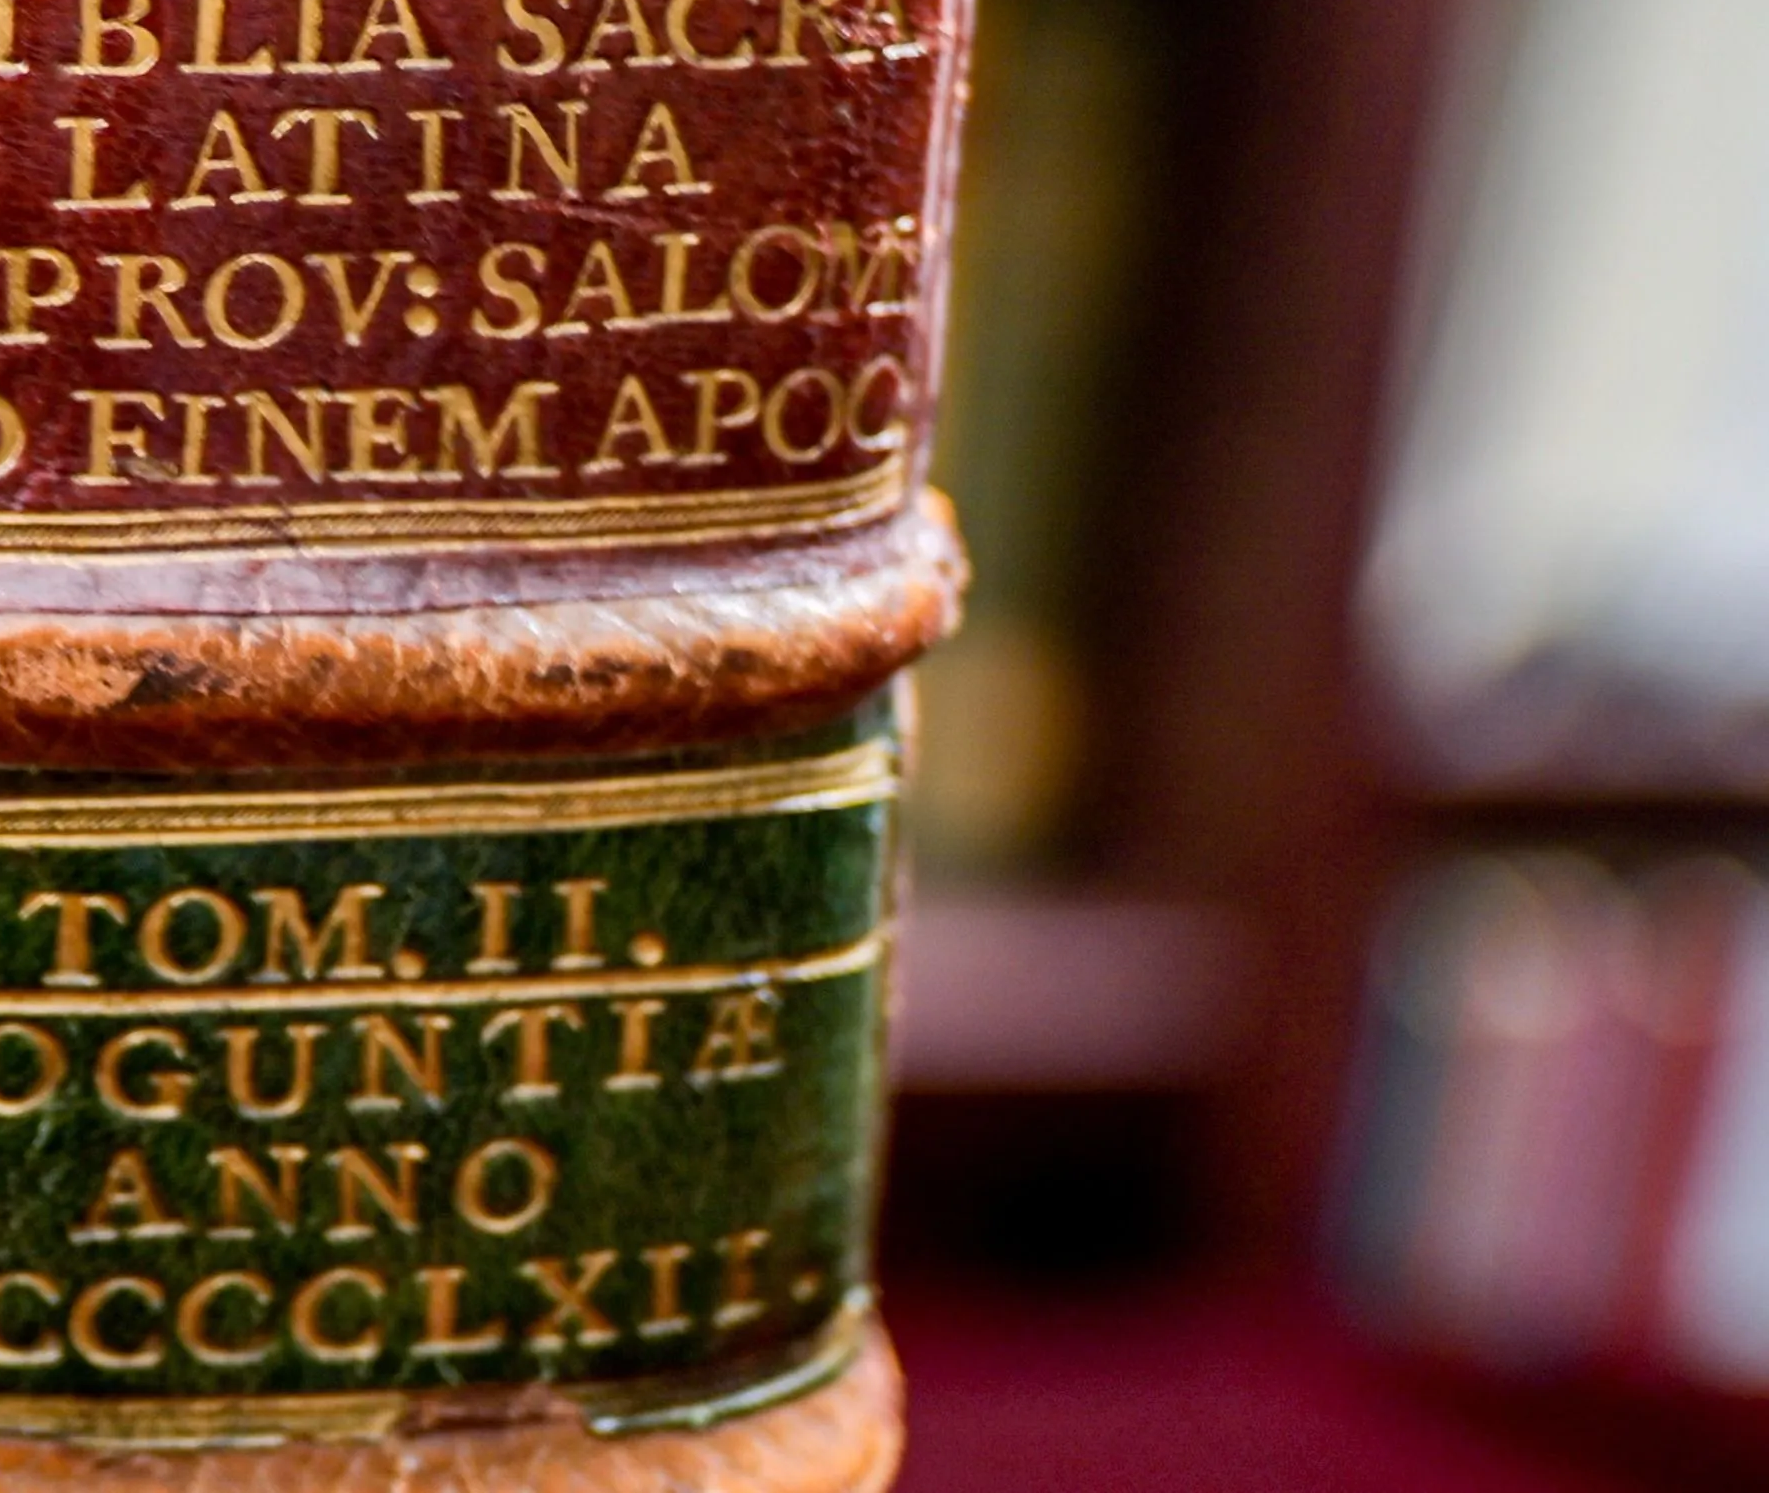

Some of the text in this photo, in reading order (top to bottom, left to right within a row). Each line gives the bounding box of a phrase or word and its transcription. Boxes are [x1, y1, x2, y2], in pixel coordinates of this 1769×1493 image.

[52, 101, 715, 212] LATINA
[69, 379, 561, 487] FINEM
[579, 356, 913, 469] APOC
[19, 878, 665, 989] TOM. II.
[67, 1137, 557, 1243] ANNO
